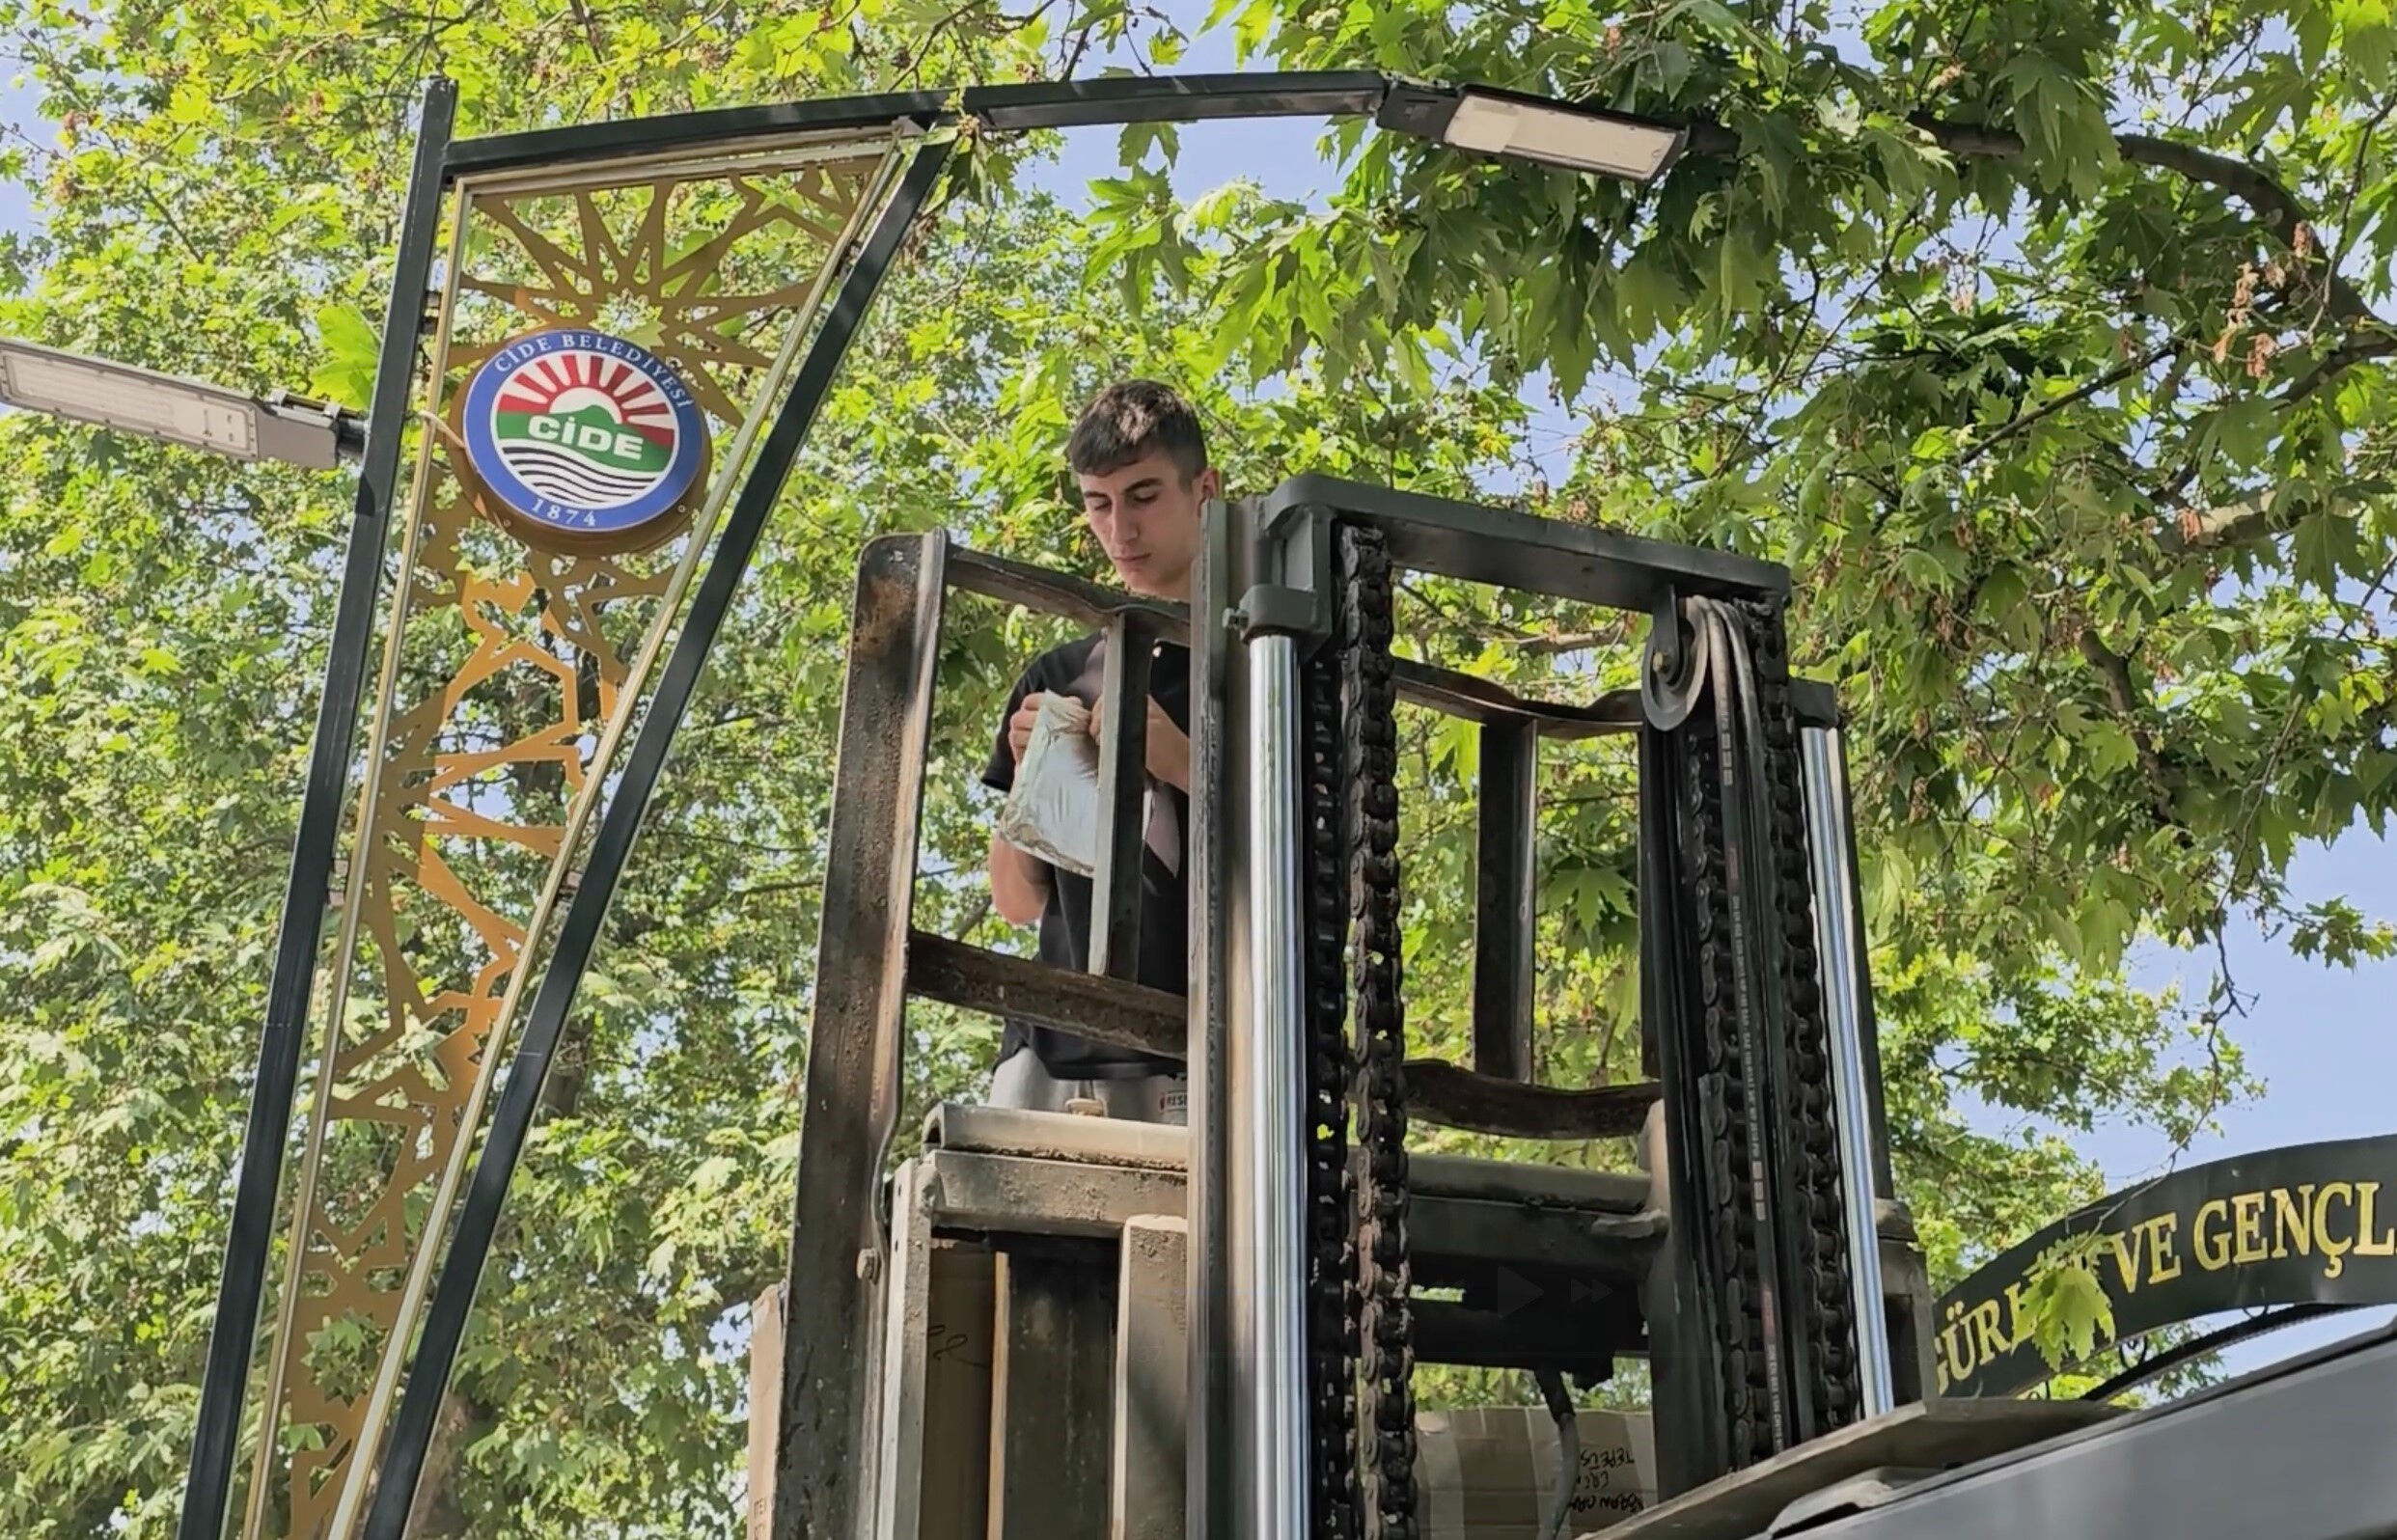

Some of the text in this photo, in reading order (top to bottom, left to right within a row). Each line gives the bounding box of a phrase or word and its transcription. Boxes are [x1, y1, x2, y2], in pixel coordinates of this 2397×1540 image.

[532, 499, 596, 527] 1874
[2108, 1212, 2182, 1293] VE
[2193, 1181, 2397, 1279] GENÇL
